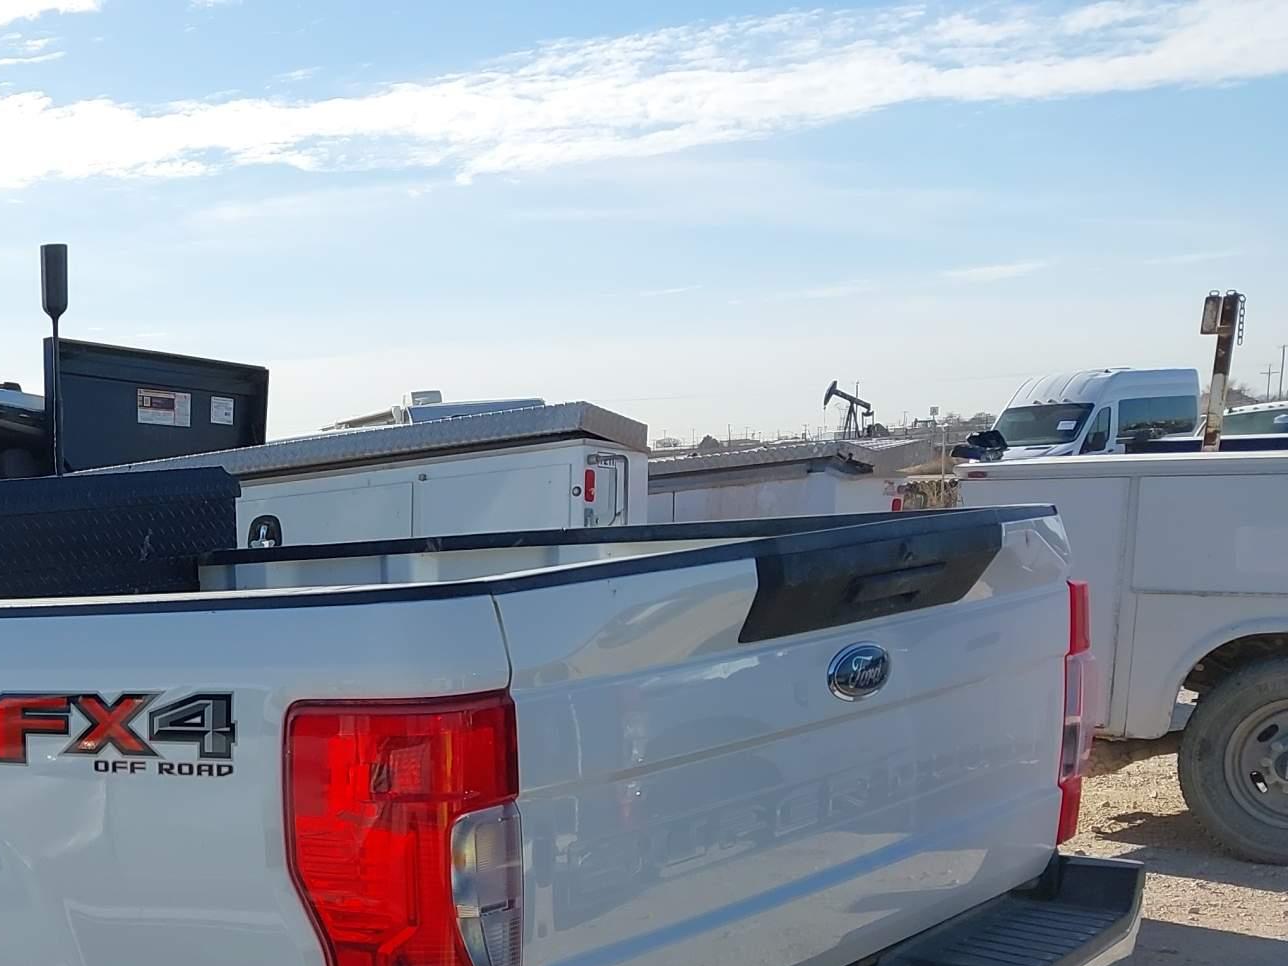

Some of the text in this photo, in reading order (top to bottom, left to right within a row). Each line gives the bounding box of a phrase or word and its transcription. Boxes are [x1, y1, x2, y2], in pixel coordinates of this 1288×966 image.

[848, 655, 882, 689] Ford
[94, 760, 233, 777] OFF ROAD
